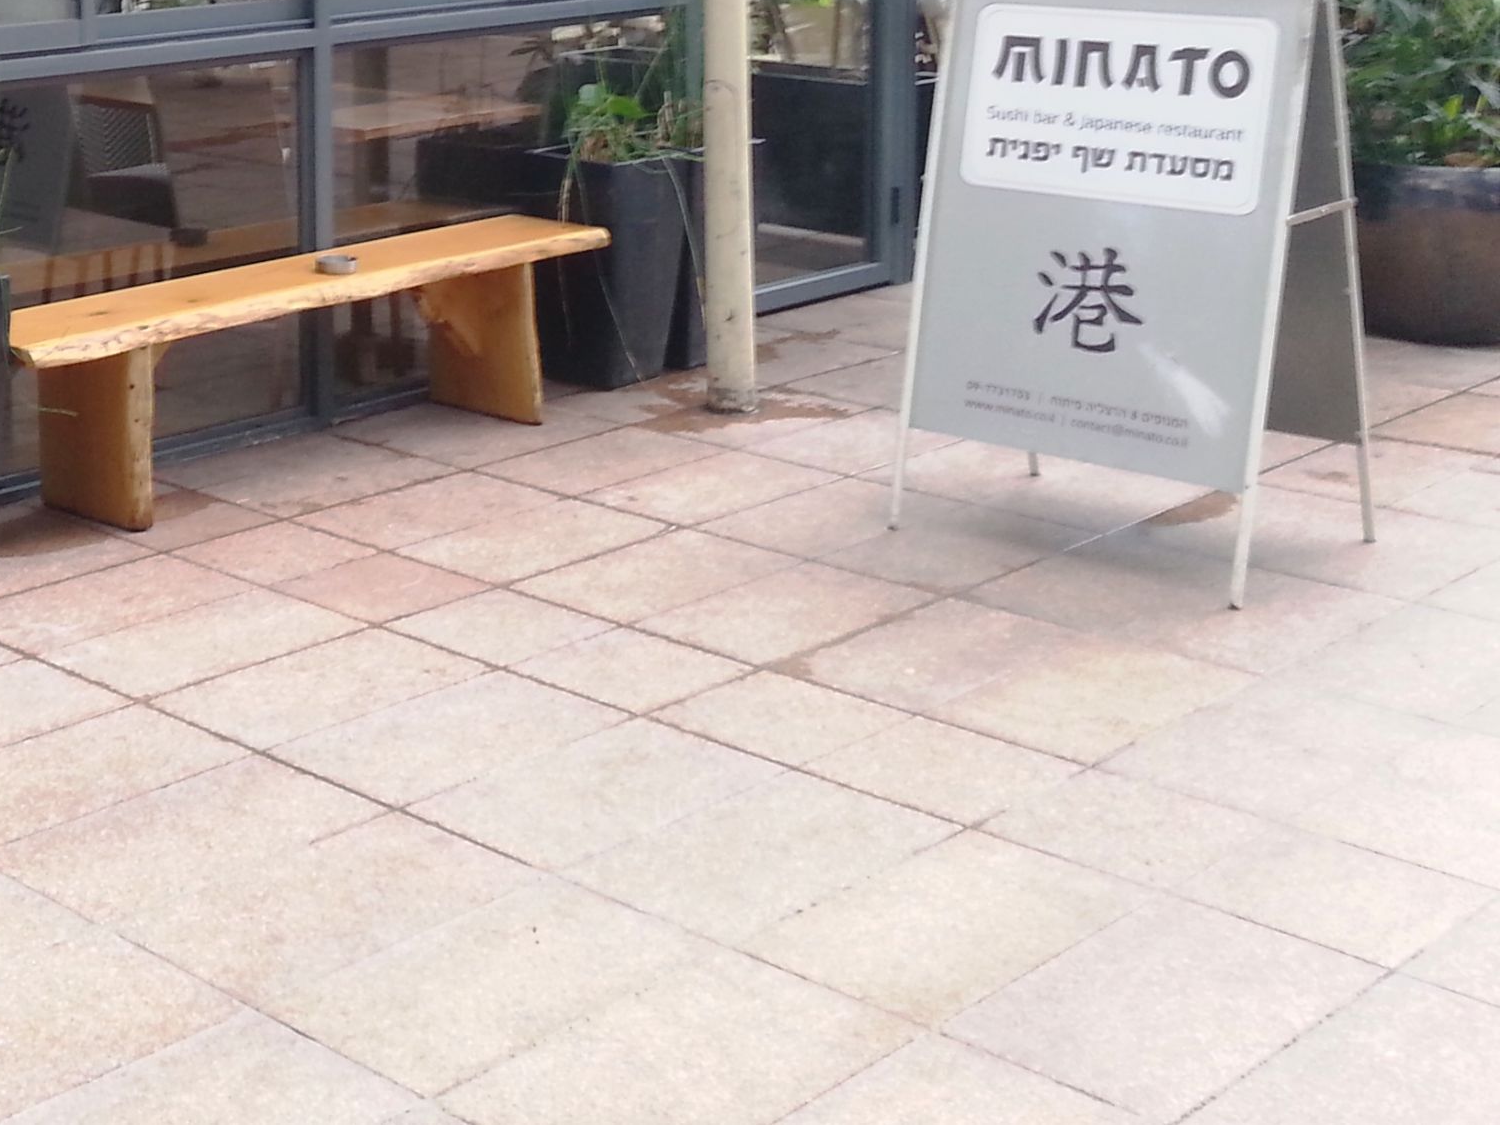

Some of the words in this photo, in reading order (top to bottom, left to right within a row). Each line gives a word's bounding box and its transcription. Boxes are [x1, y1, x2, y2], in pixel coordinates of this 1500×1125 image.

[991, 35, 1251, 99] MINATO
[987, 105, 1029, 122] Sushi
[1033, 111, 1058, 125] bar
[1063, 112, 1075, 127] &
[1157, 124, 1244, 142] restaurant
[986, 137, 1061, 161] יפנית
[1072, 145, 1116, 173] שף
[1124, 150, 1235, 181] מסעדת
[1033, 246, 1143, 353] 港
